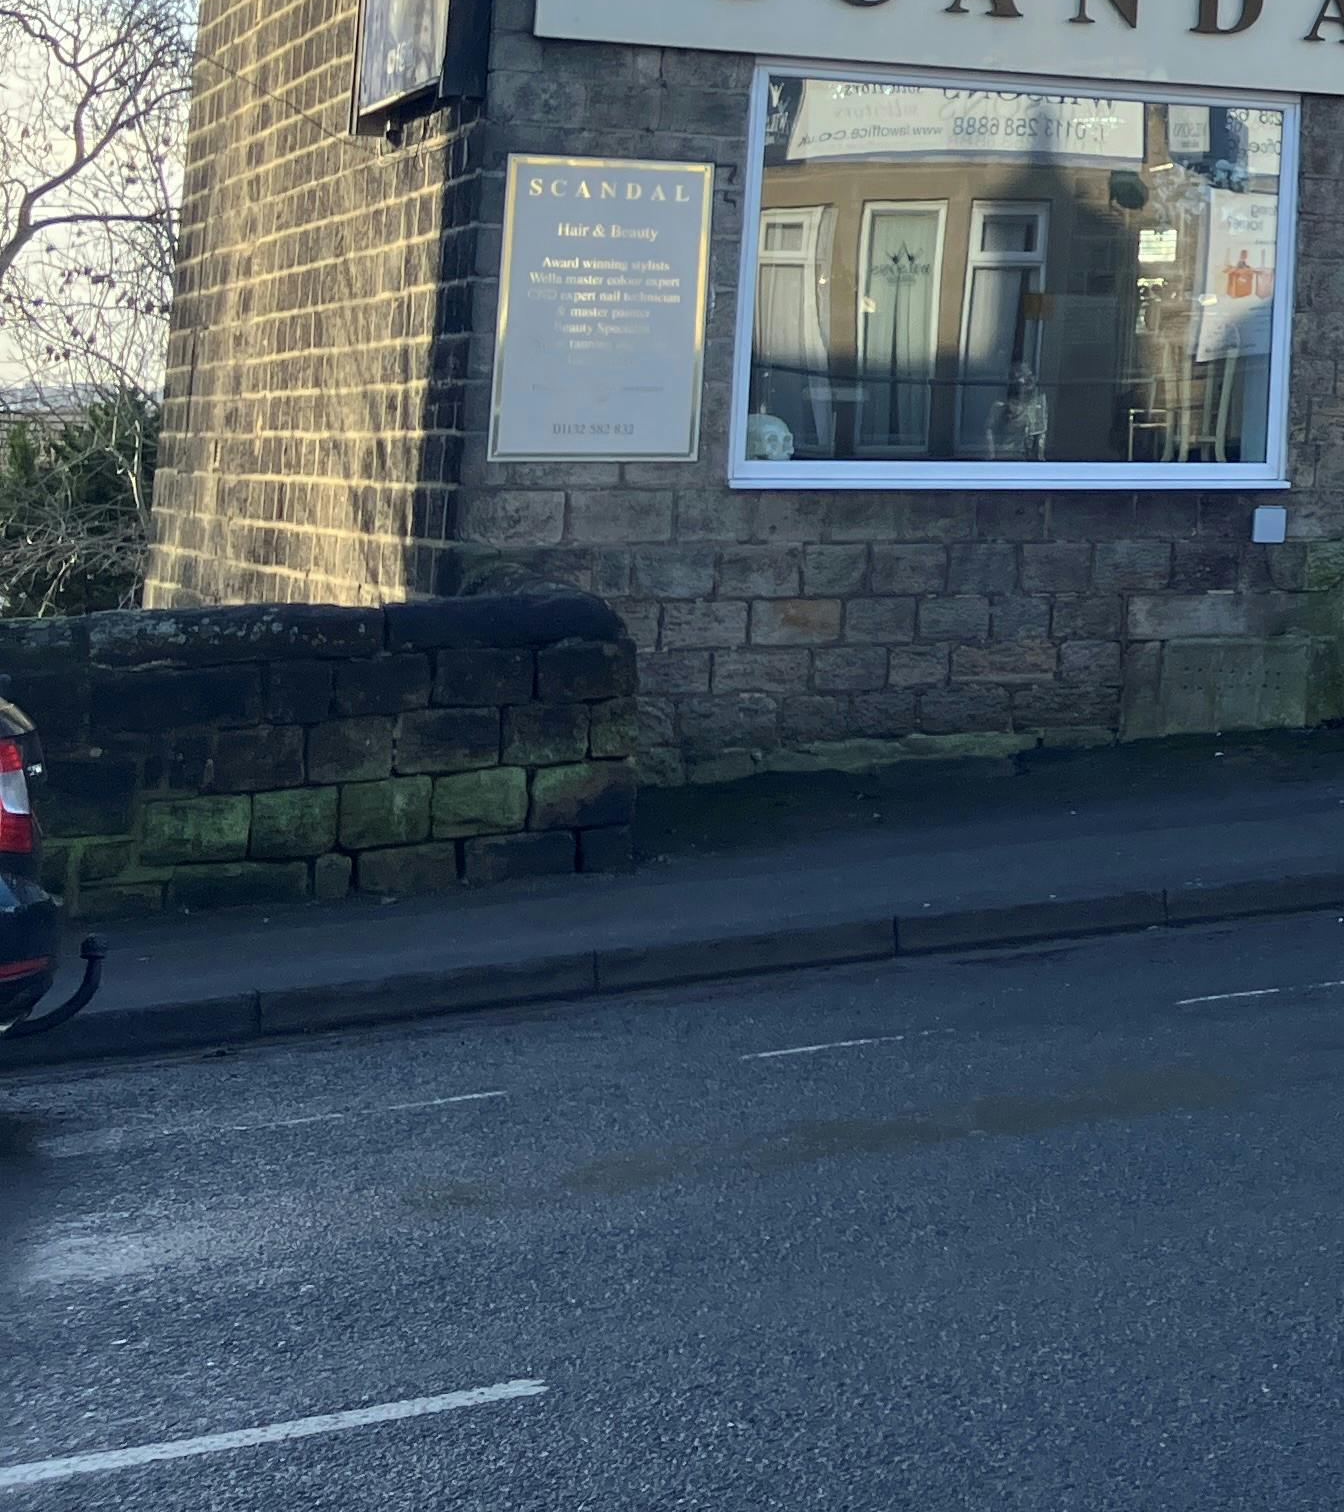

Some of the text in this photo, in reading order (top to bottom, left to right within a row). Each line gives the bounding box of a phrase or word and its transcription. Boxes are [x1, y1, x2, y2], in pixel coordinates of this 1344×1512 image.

[528, 178, 690, 202] SCANDAL
[557, 223, 659, 242] Hair & Beauty
[542, 257, 580, 269] Award
[582, 259, 628, 272] winning
[528, 272, 681, 290] Wella master colour expert
[560, 291, 596, 304] expert
[599, 291, 621, 302] nail
[623, 292, 681, 303] technician
[570, 307, 609, 318] master
